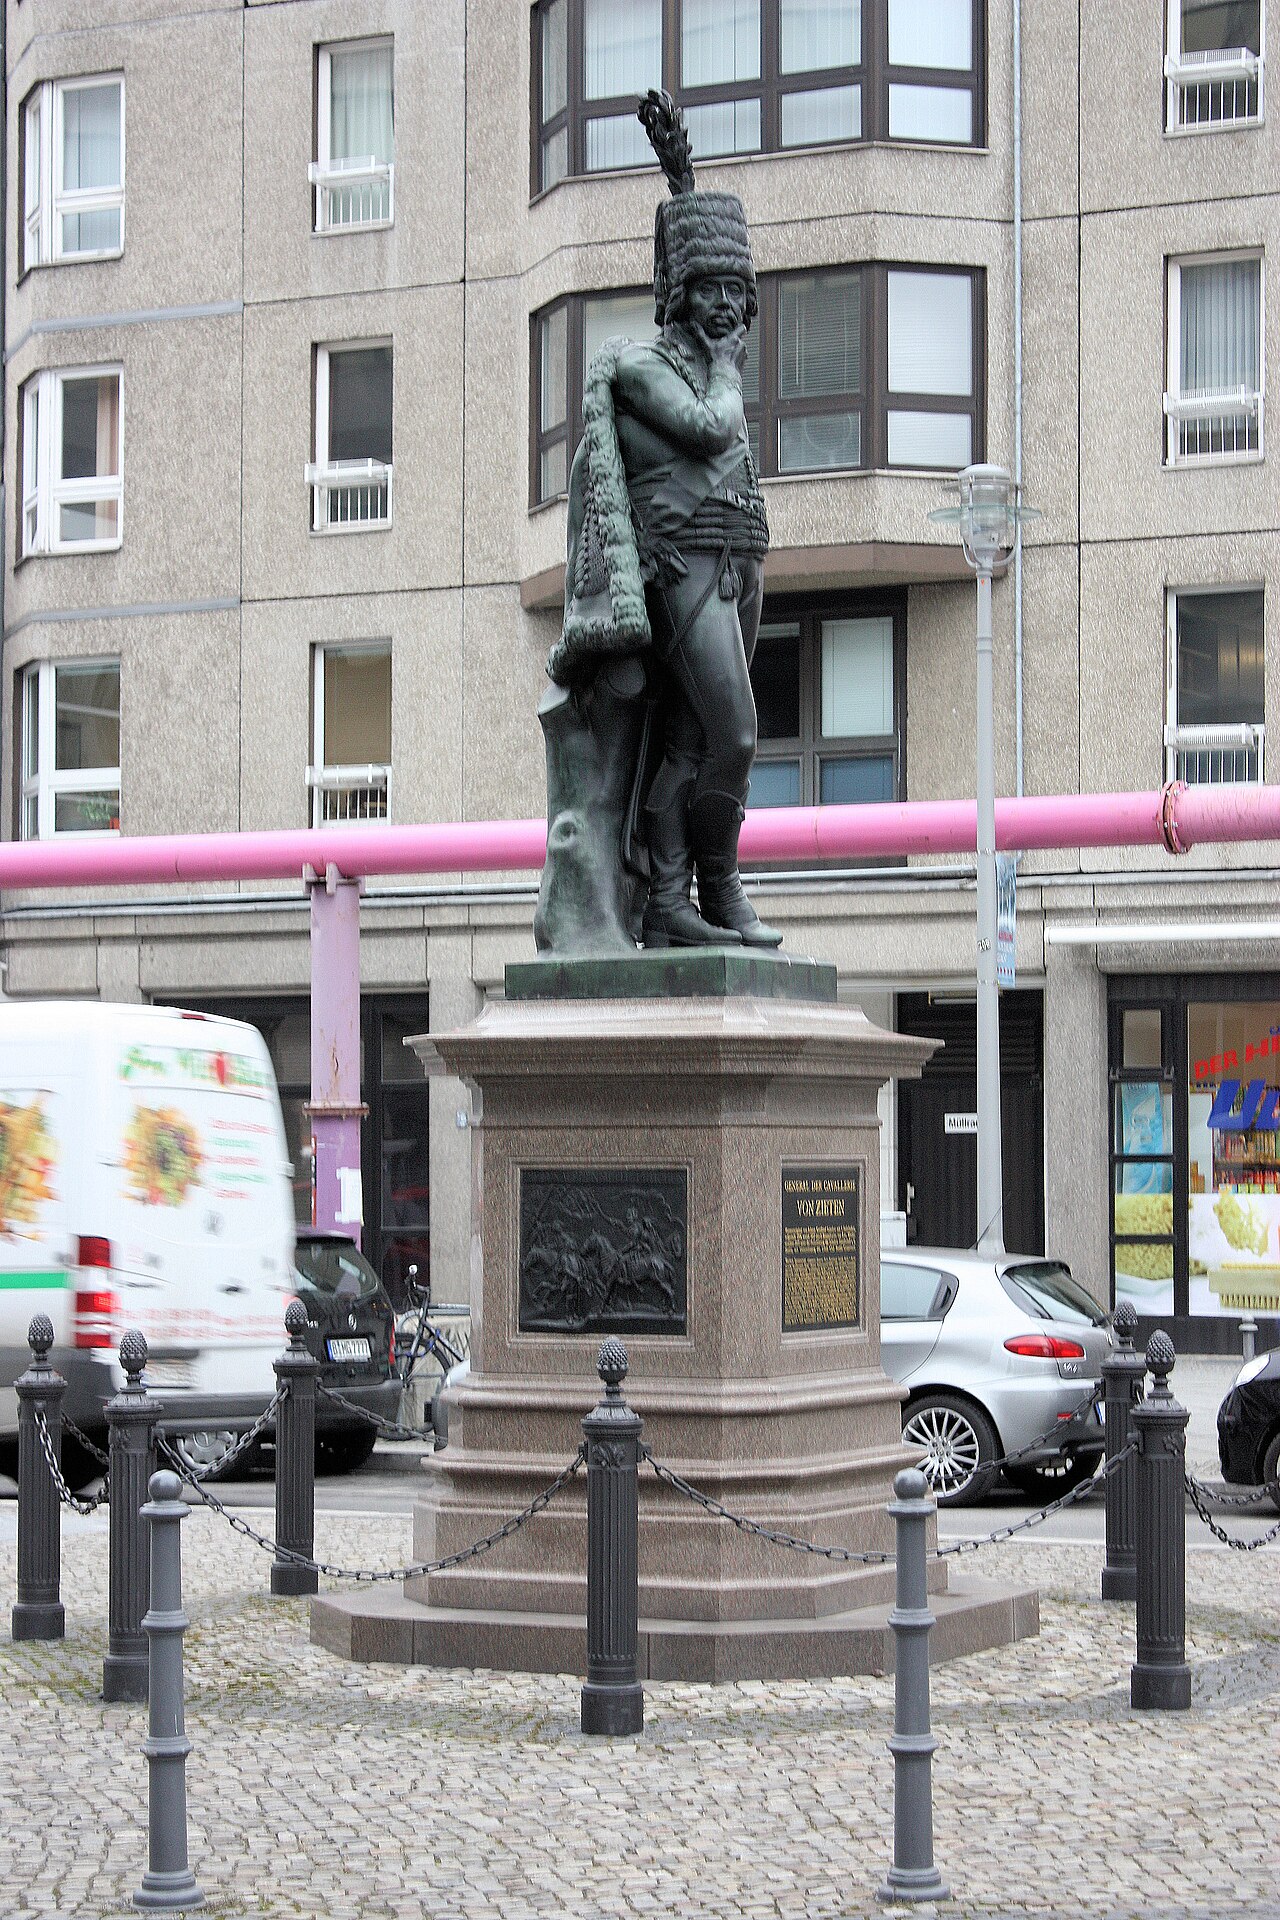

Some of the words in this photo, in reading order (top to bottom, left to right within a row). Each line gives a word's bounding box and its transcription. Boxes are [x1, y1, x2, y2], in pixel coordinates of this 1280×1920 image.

[1194, 1049, 1239, 1080] DER
[948, 1116, 978, 1129] Müllra
[796, 1199, 815, 1217] VON
